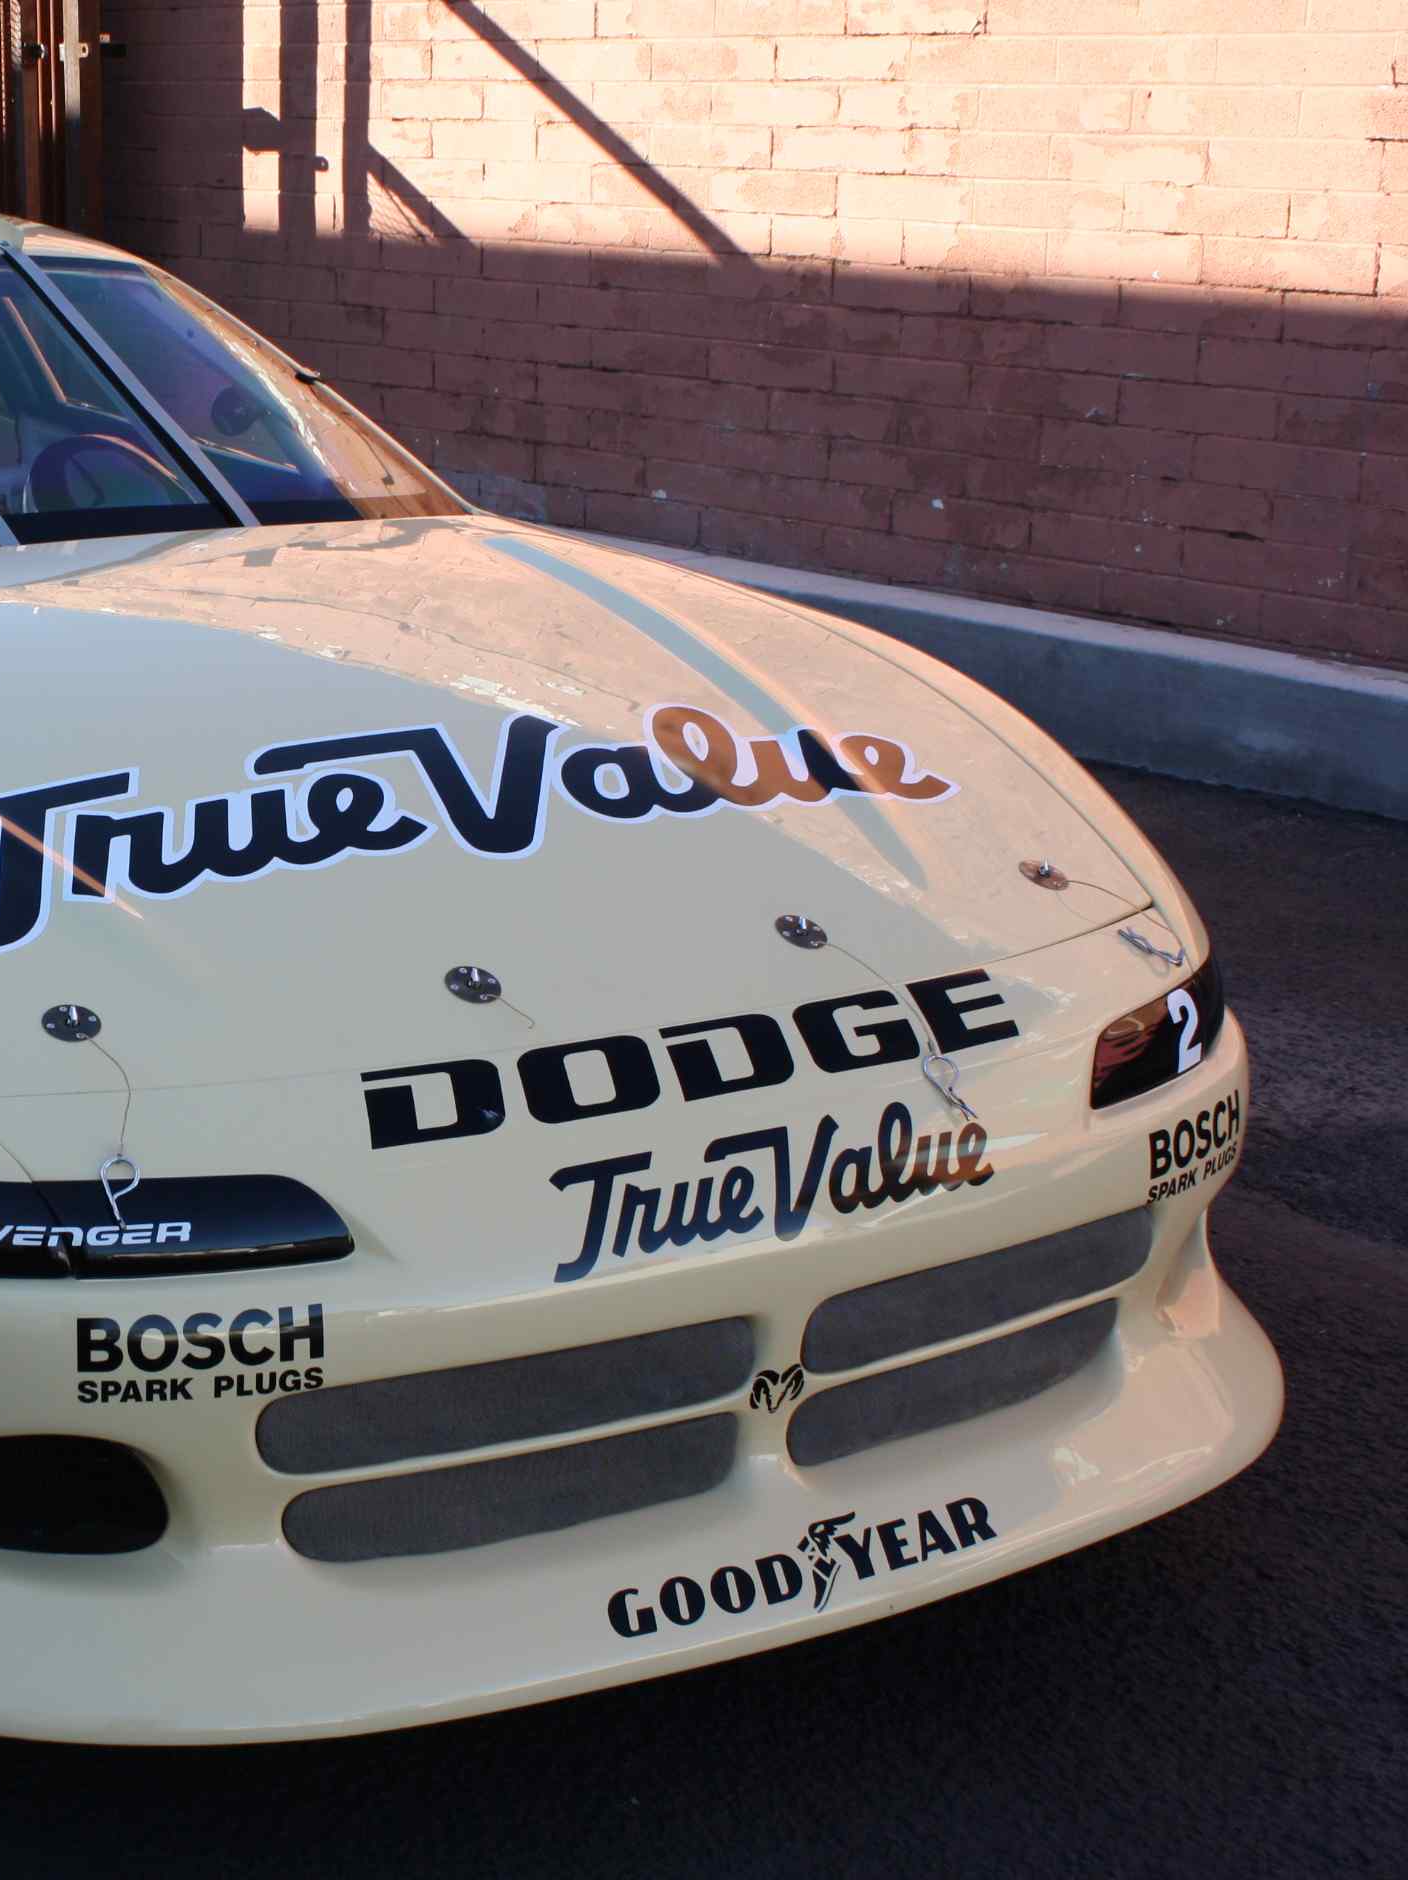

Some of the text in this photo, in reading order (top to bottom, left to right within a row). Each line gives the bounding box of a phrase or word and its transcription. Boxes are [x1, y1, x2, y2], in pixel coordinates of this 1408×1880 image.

[360, 968, 1020, 1150] DODGE
[1166, 988, 1203, 1074] 2
[1147, 1143, 1238, 1204] SPARK PLUGS
[1148, 1089, 1241, 1180] BOSCH
[76, 1302, 325, 1374] BOSCH
[77, 1366, 325, 1404] SPARK PLUGS
